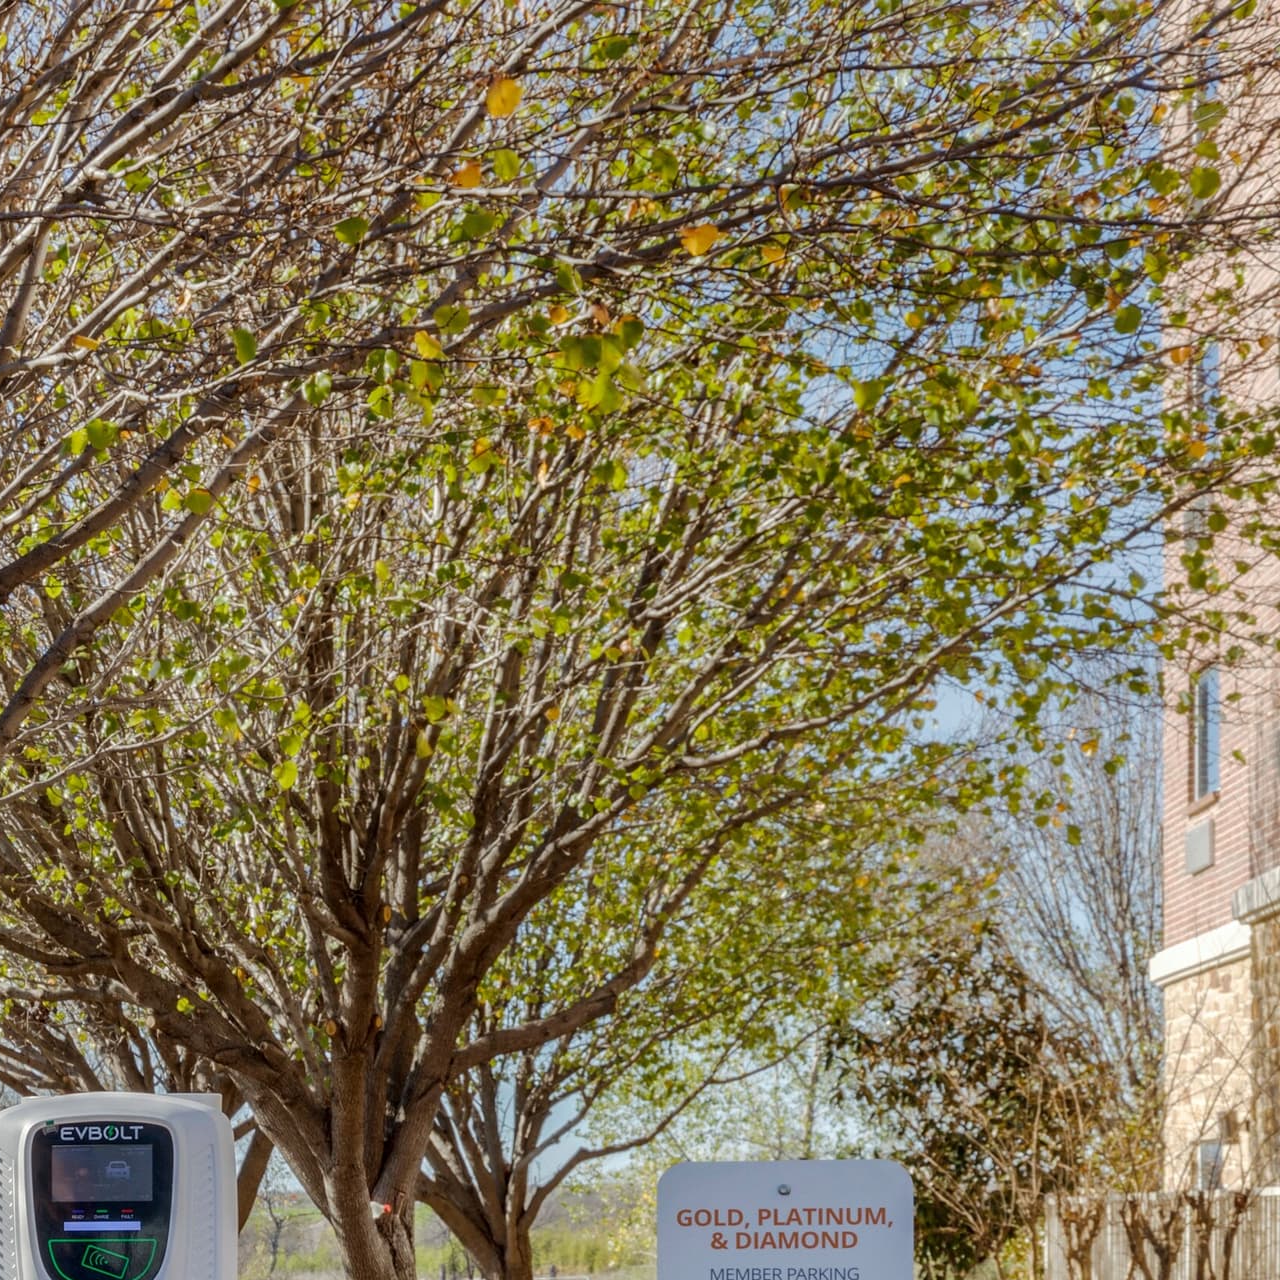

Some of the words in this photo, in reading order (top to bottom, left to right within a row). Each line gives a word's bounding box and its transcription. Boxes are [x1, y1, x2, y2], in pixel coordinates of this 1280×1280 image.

[60, 1124, 144, 1141] EVBOLT
[676, 1208, 750, 1229] GOLD,
[757, 1207, 894, 1228] PLATINUM,
[710, 1232, 728, 1250] &
[735, 1231, 858, 1249] DIAMOND
[710, 1268, 782, 1280] MEMBER
[787, 1267, 860, 1280] PARKING
